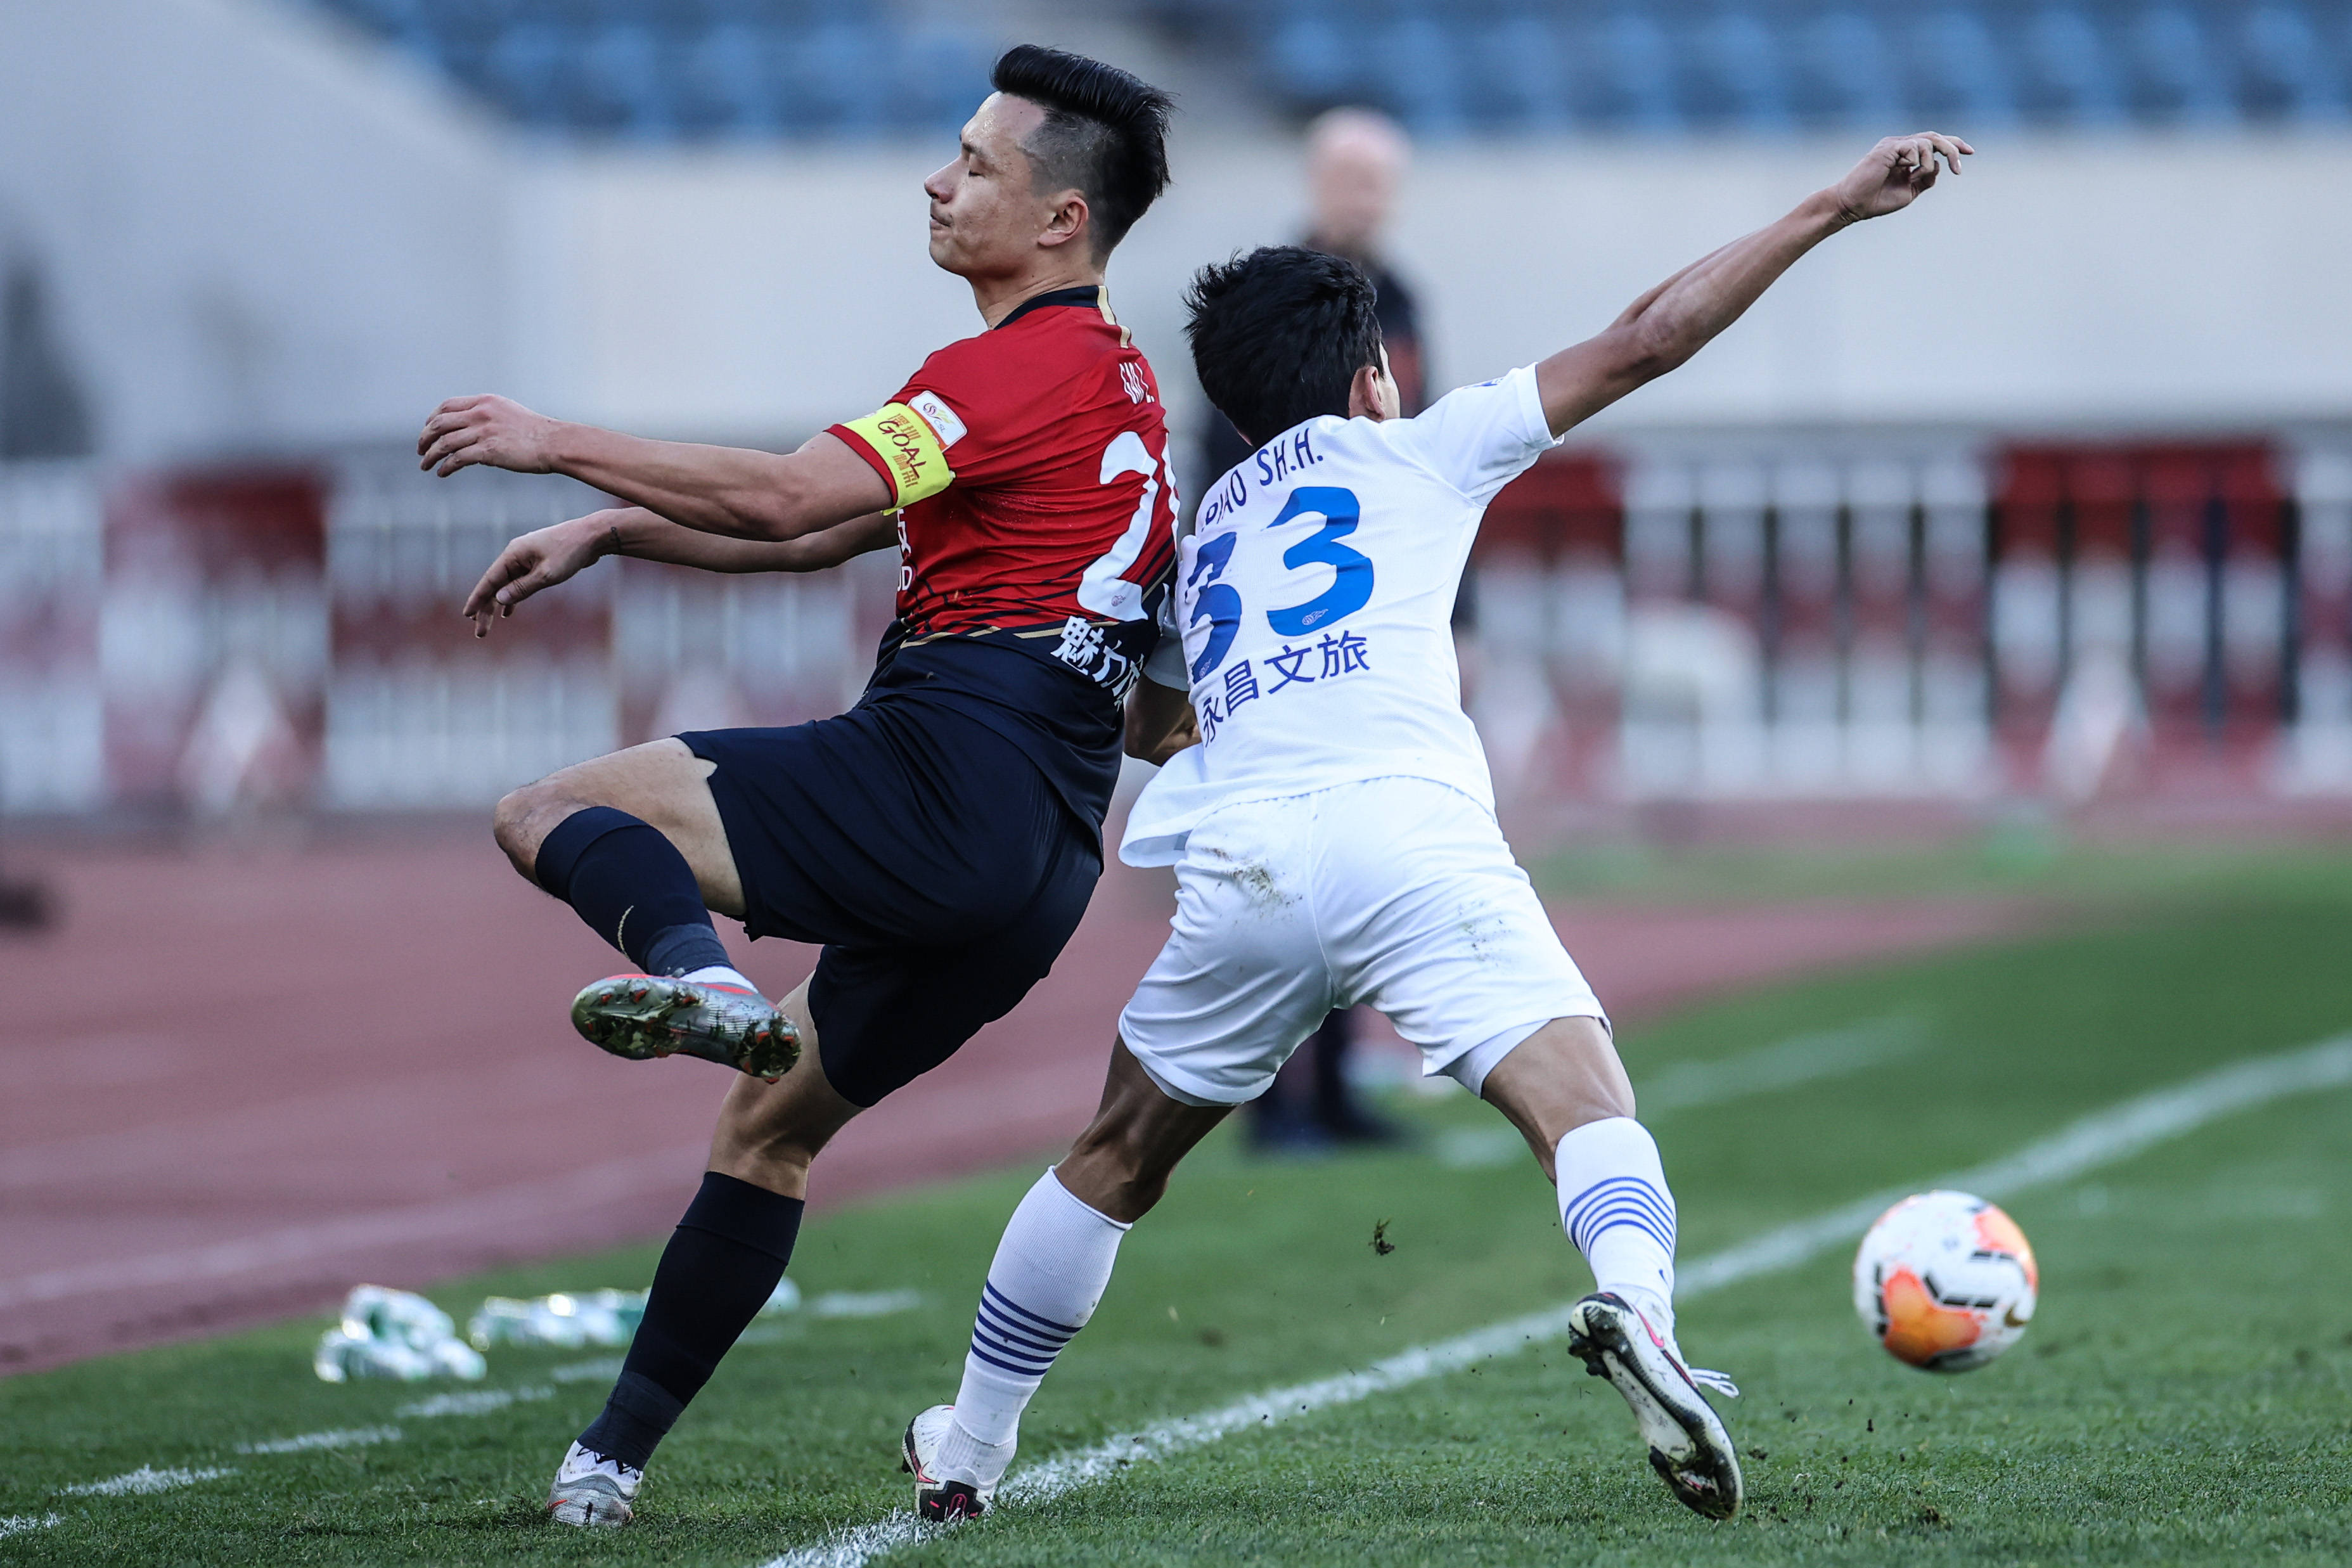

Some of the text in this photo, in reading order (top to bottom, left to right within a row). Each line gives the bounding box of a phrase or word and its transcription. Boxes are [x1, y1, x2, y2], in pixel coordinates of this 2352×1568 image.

[877, 420, 927, 479] GOAL
[934, 419, 946, 434] CSL
[1257, 428, 1323, 486] SH.H.
[1077, 431, 1180, 636] 2
[1184, 486, 1374, 684] 33
[1203, 631, 1371, 748] 永昌文旅
